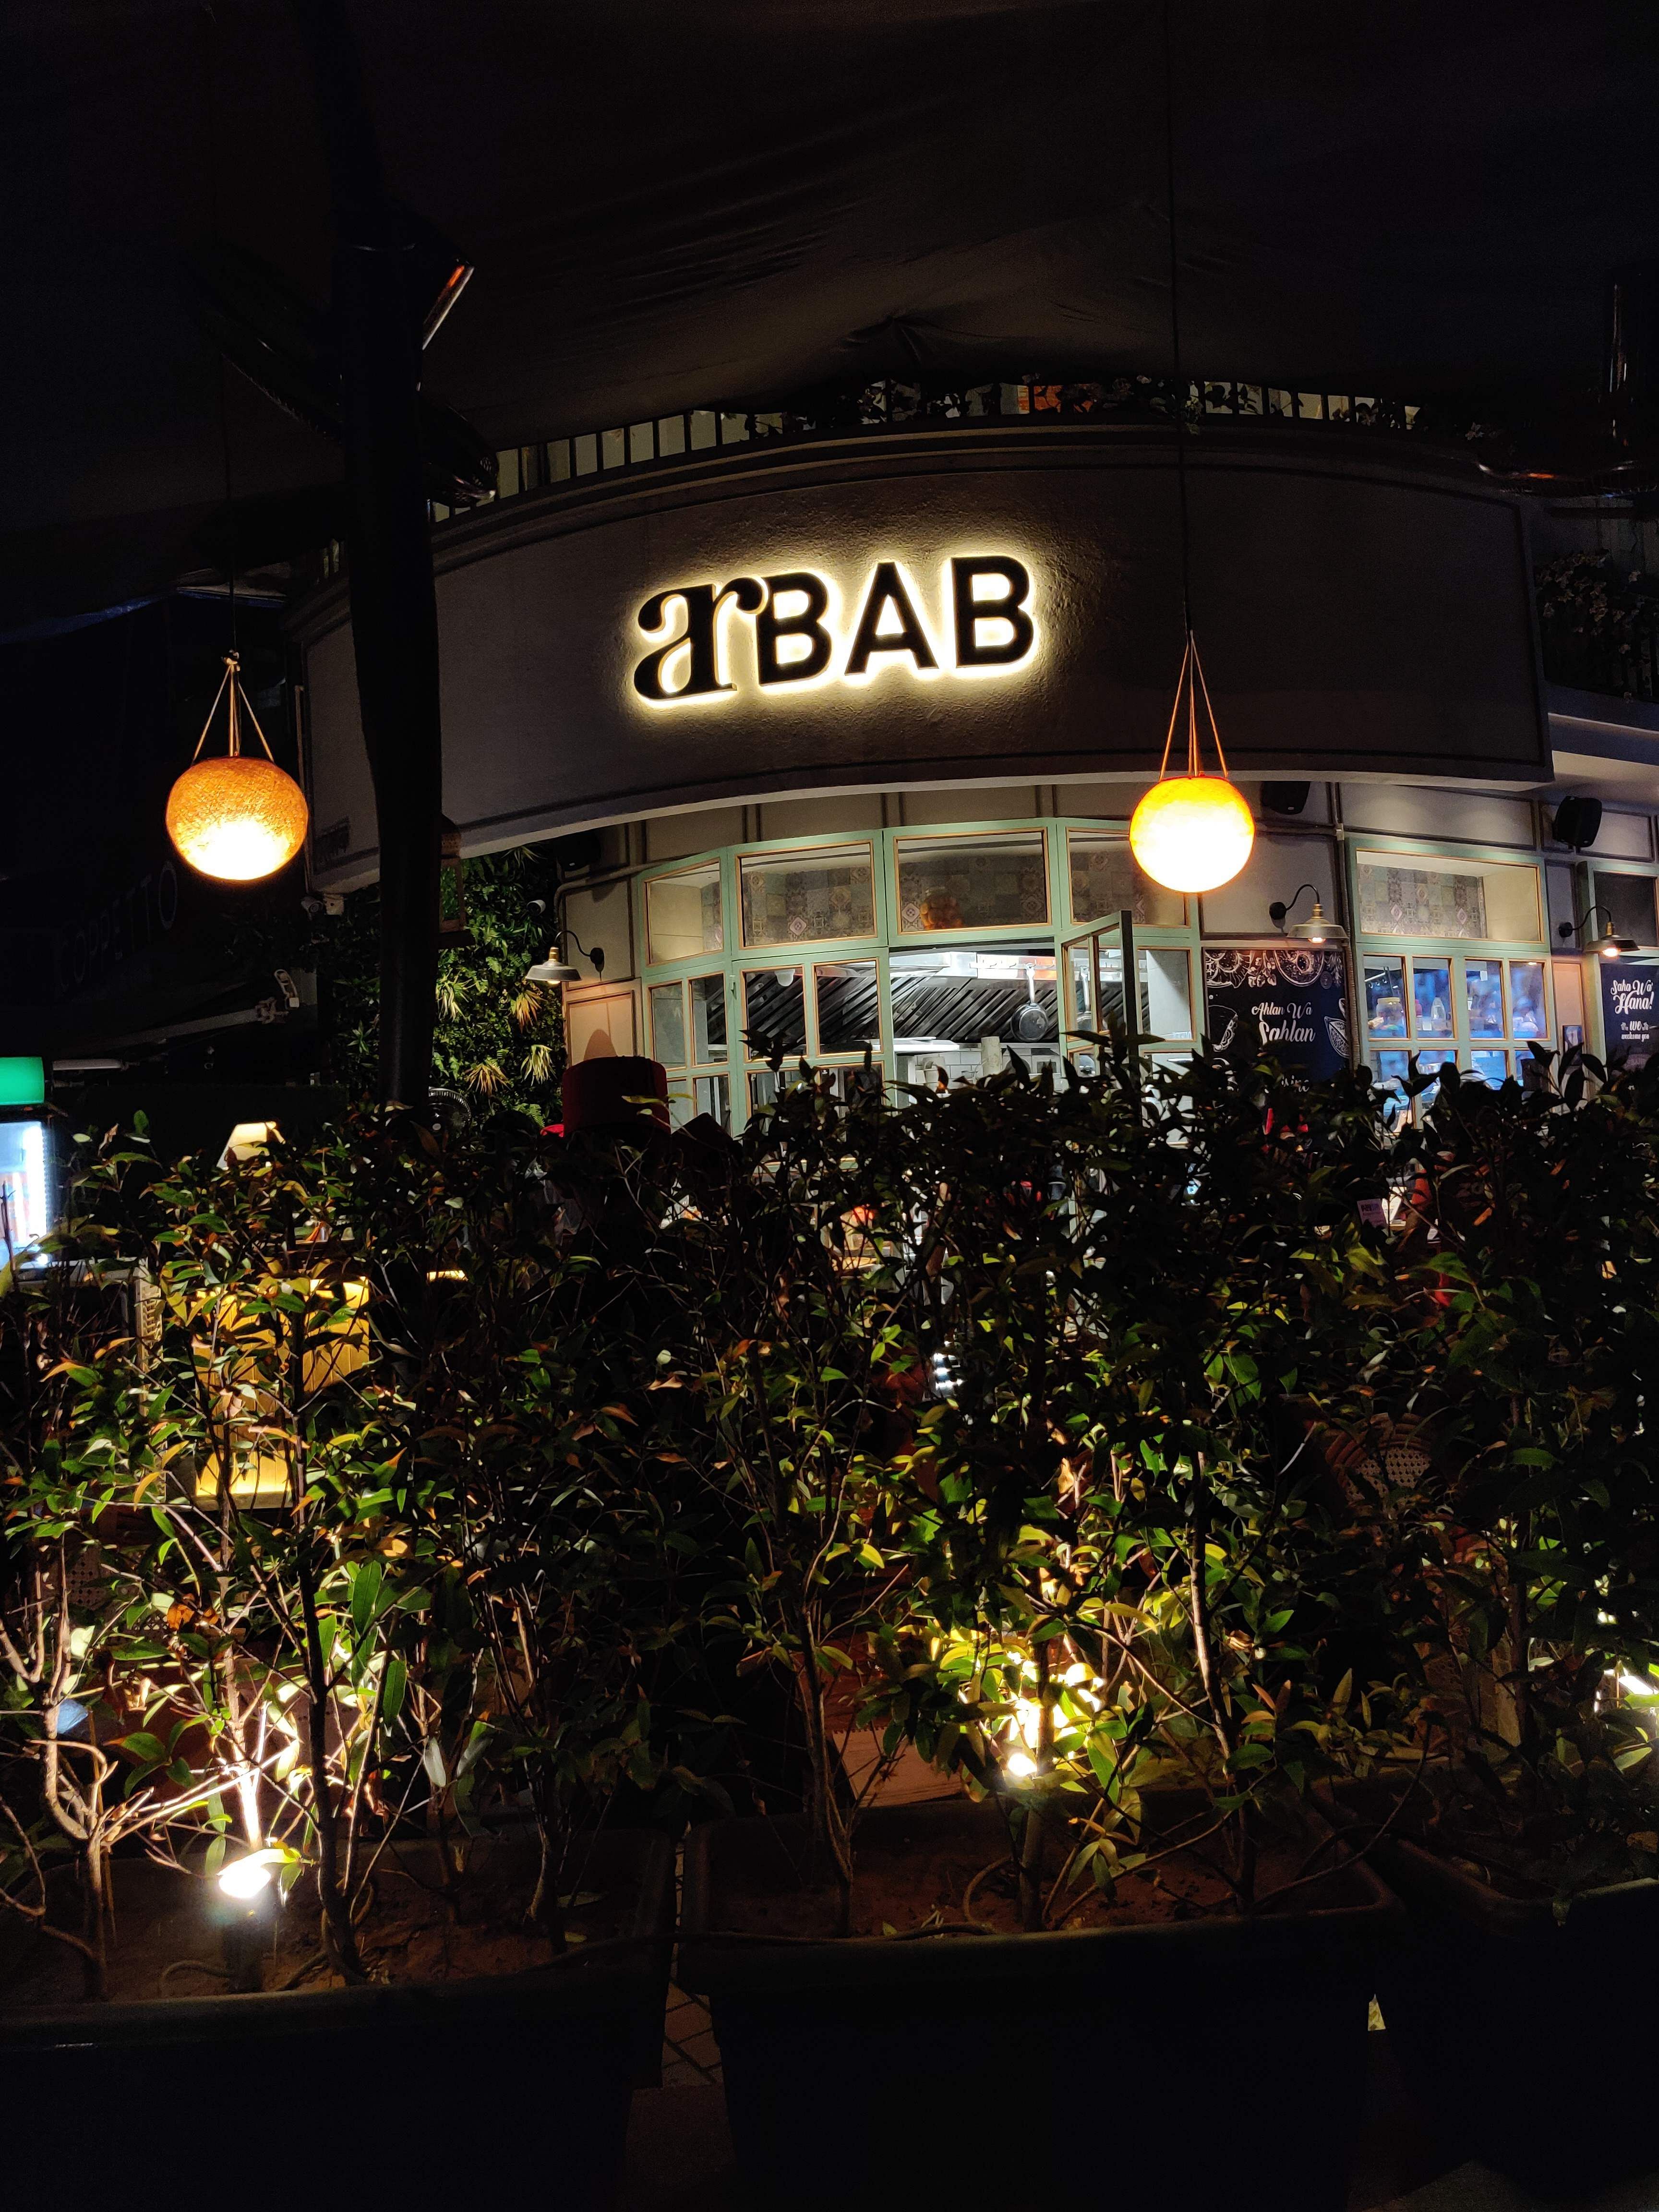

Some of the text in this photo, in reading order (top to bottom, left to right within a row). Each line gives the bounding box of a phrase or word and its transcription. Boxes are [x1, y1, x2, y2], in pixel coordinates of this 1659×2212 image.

[634, 555, 1034, 702] arBAB
[1610, 979, 1632, 995] Saha
[1251, 1002, 1285, 1022] Ahlan
[1613, 990, 1654, 1015] Hana!
[1258, 1019, 1316, 1046] Sahlan
